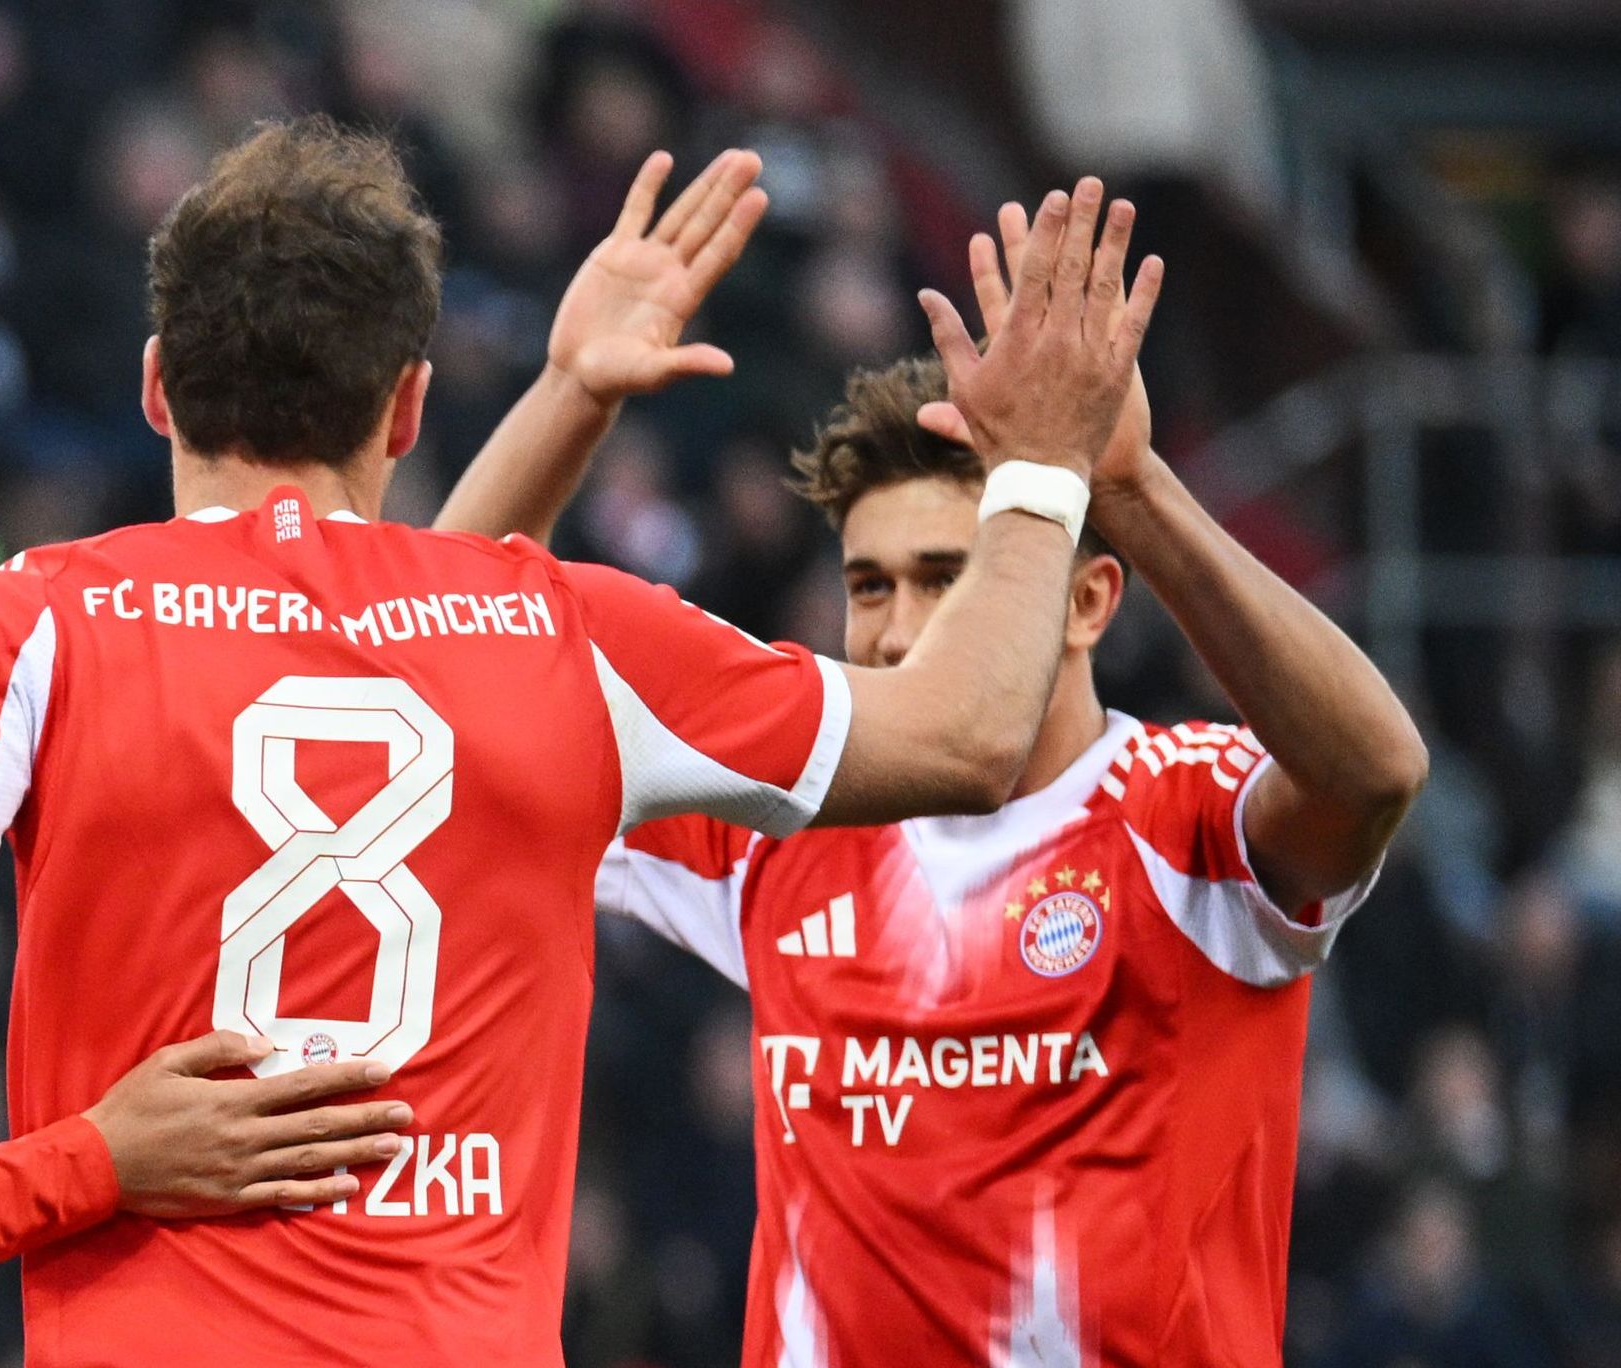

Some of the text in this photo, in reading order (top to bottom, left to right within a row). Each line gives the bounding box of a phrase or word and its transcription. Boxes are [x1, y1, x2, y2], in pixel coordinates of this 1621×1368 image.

[273, 499, 300, 515] MIA
[274, 513, 301, 529] SAN
[276, 526, 302, 543] MIA
[82, 578, 144, 617] FC
[340, 590, 557, 648] MÜNCHEN
[211, 676, 455, 1078] 8
[841, 1031, 1109, 1088] MAGENTA
[840, 1095, 913, 1147] TV
